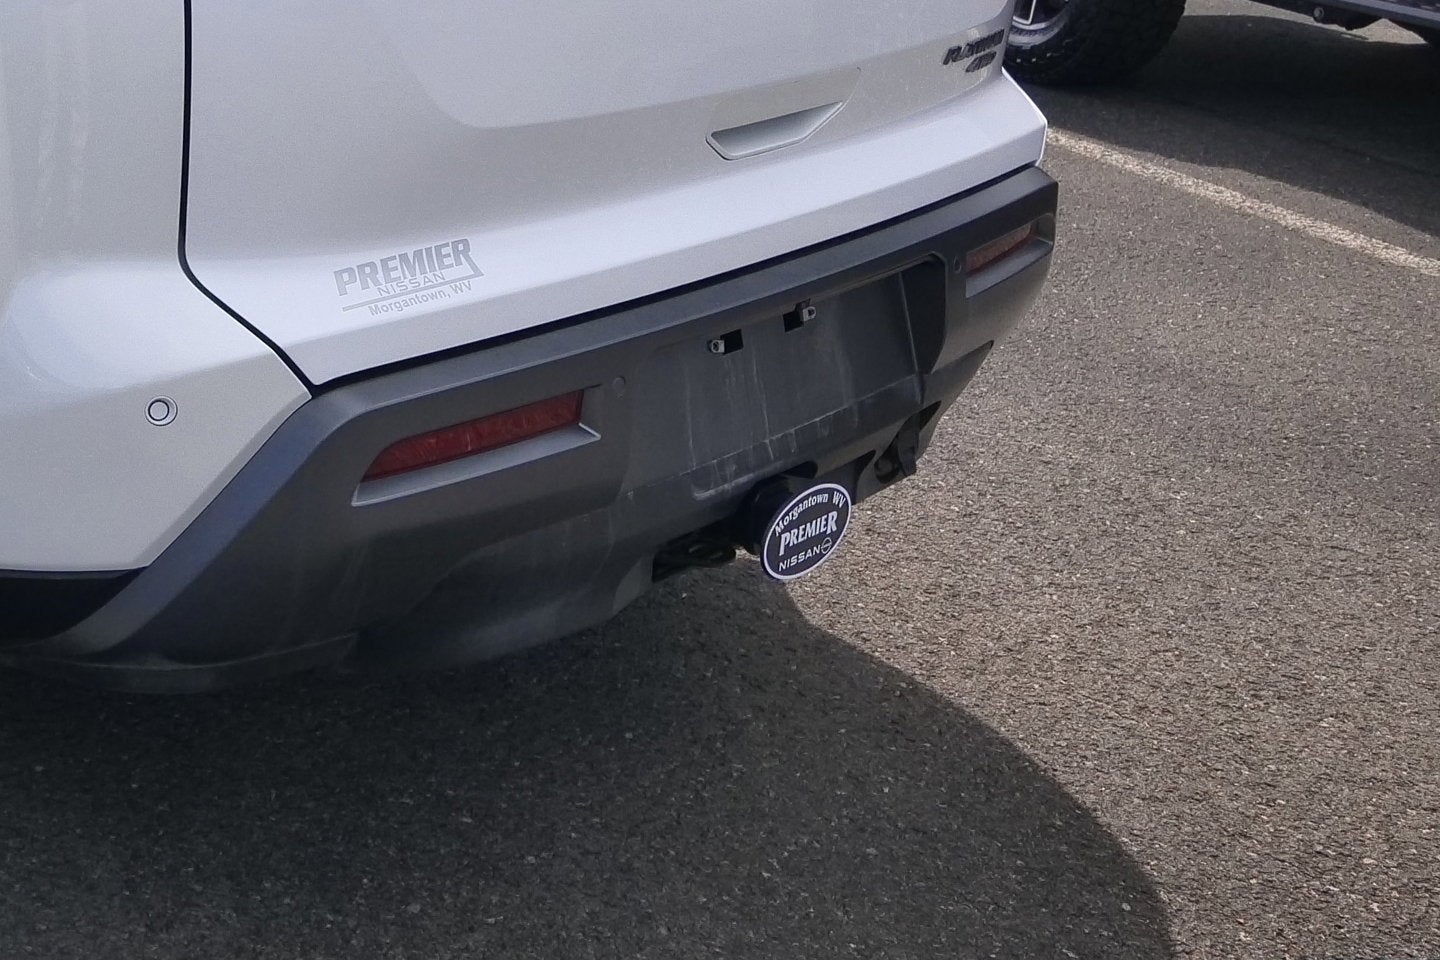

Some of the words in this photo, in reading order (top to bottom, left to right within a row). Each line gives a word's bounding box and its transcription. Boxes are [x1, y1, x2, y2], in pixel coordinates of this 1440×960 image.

[333, 238, 482, 297] PREMIER
[377, 271, 446, 297] NISSAN
[368, 289, 452, 317] Morgantown,
[449, 280, 473, 296] WV
[774, 493, 829, 537] Morgantown
[832, 491, 846, 509] WV
[778, 510, 838, 557] PREMIER
[778, 544, 821, 572] NISSAN
